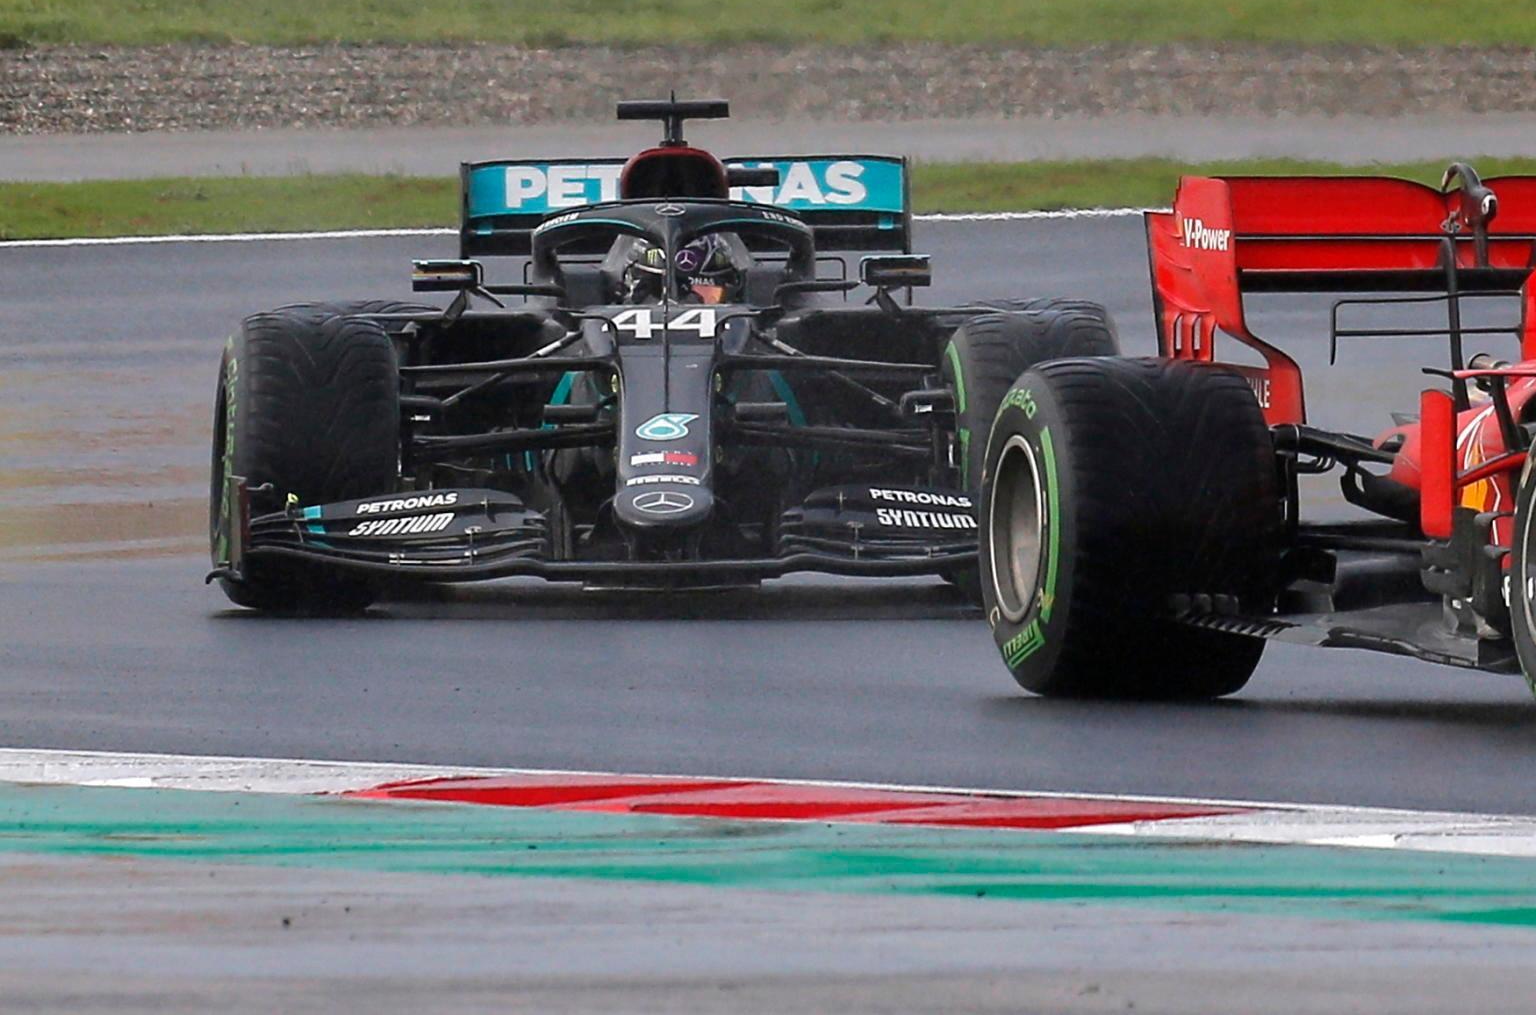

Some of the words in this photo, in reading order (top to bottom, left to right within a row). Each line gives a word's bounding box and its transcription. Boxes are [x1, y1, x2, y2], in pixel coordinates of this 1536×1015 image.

[505, 161, 867, 208] PETNAS
[1183, 218, 1231, 251] V-Power
[601, 308, 731, 339] 44
[356, 492, 458, 514] PETRONAS
[869, 488, 973, 508] PETRONAS
[348, 512, 455, 536] SYNTIUM
[876, 508, 978, 529] SYNTIUM
